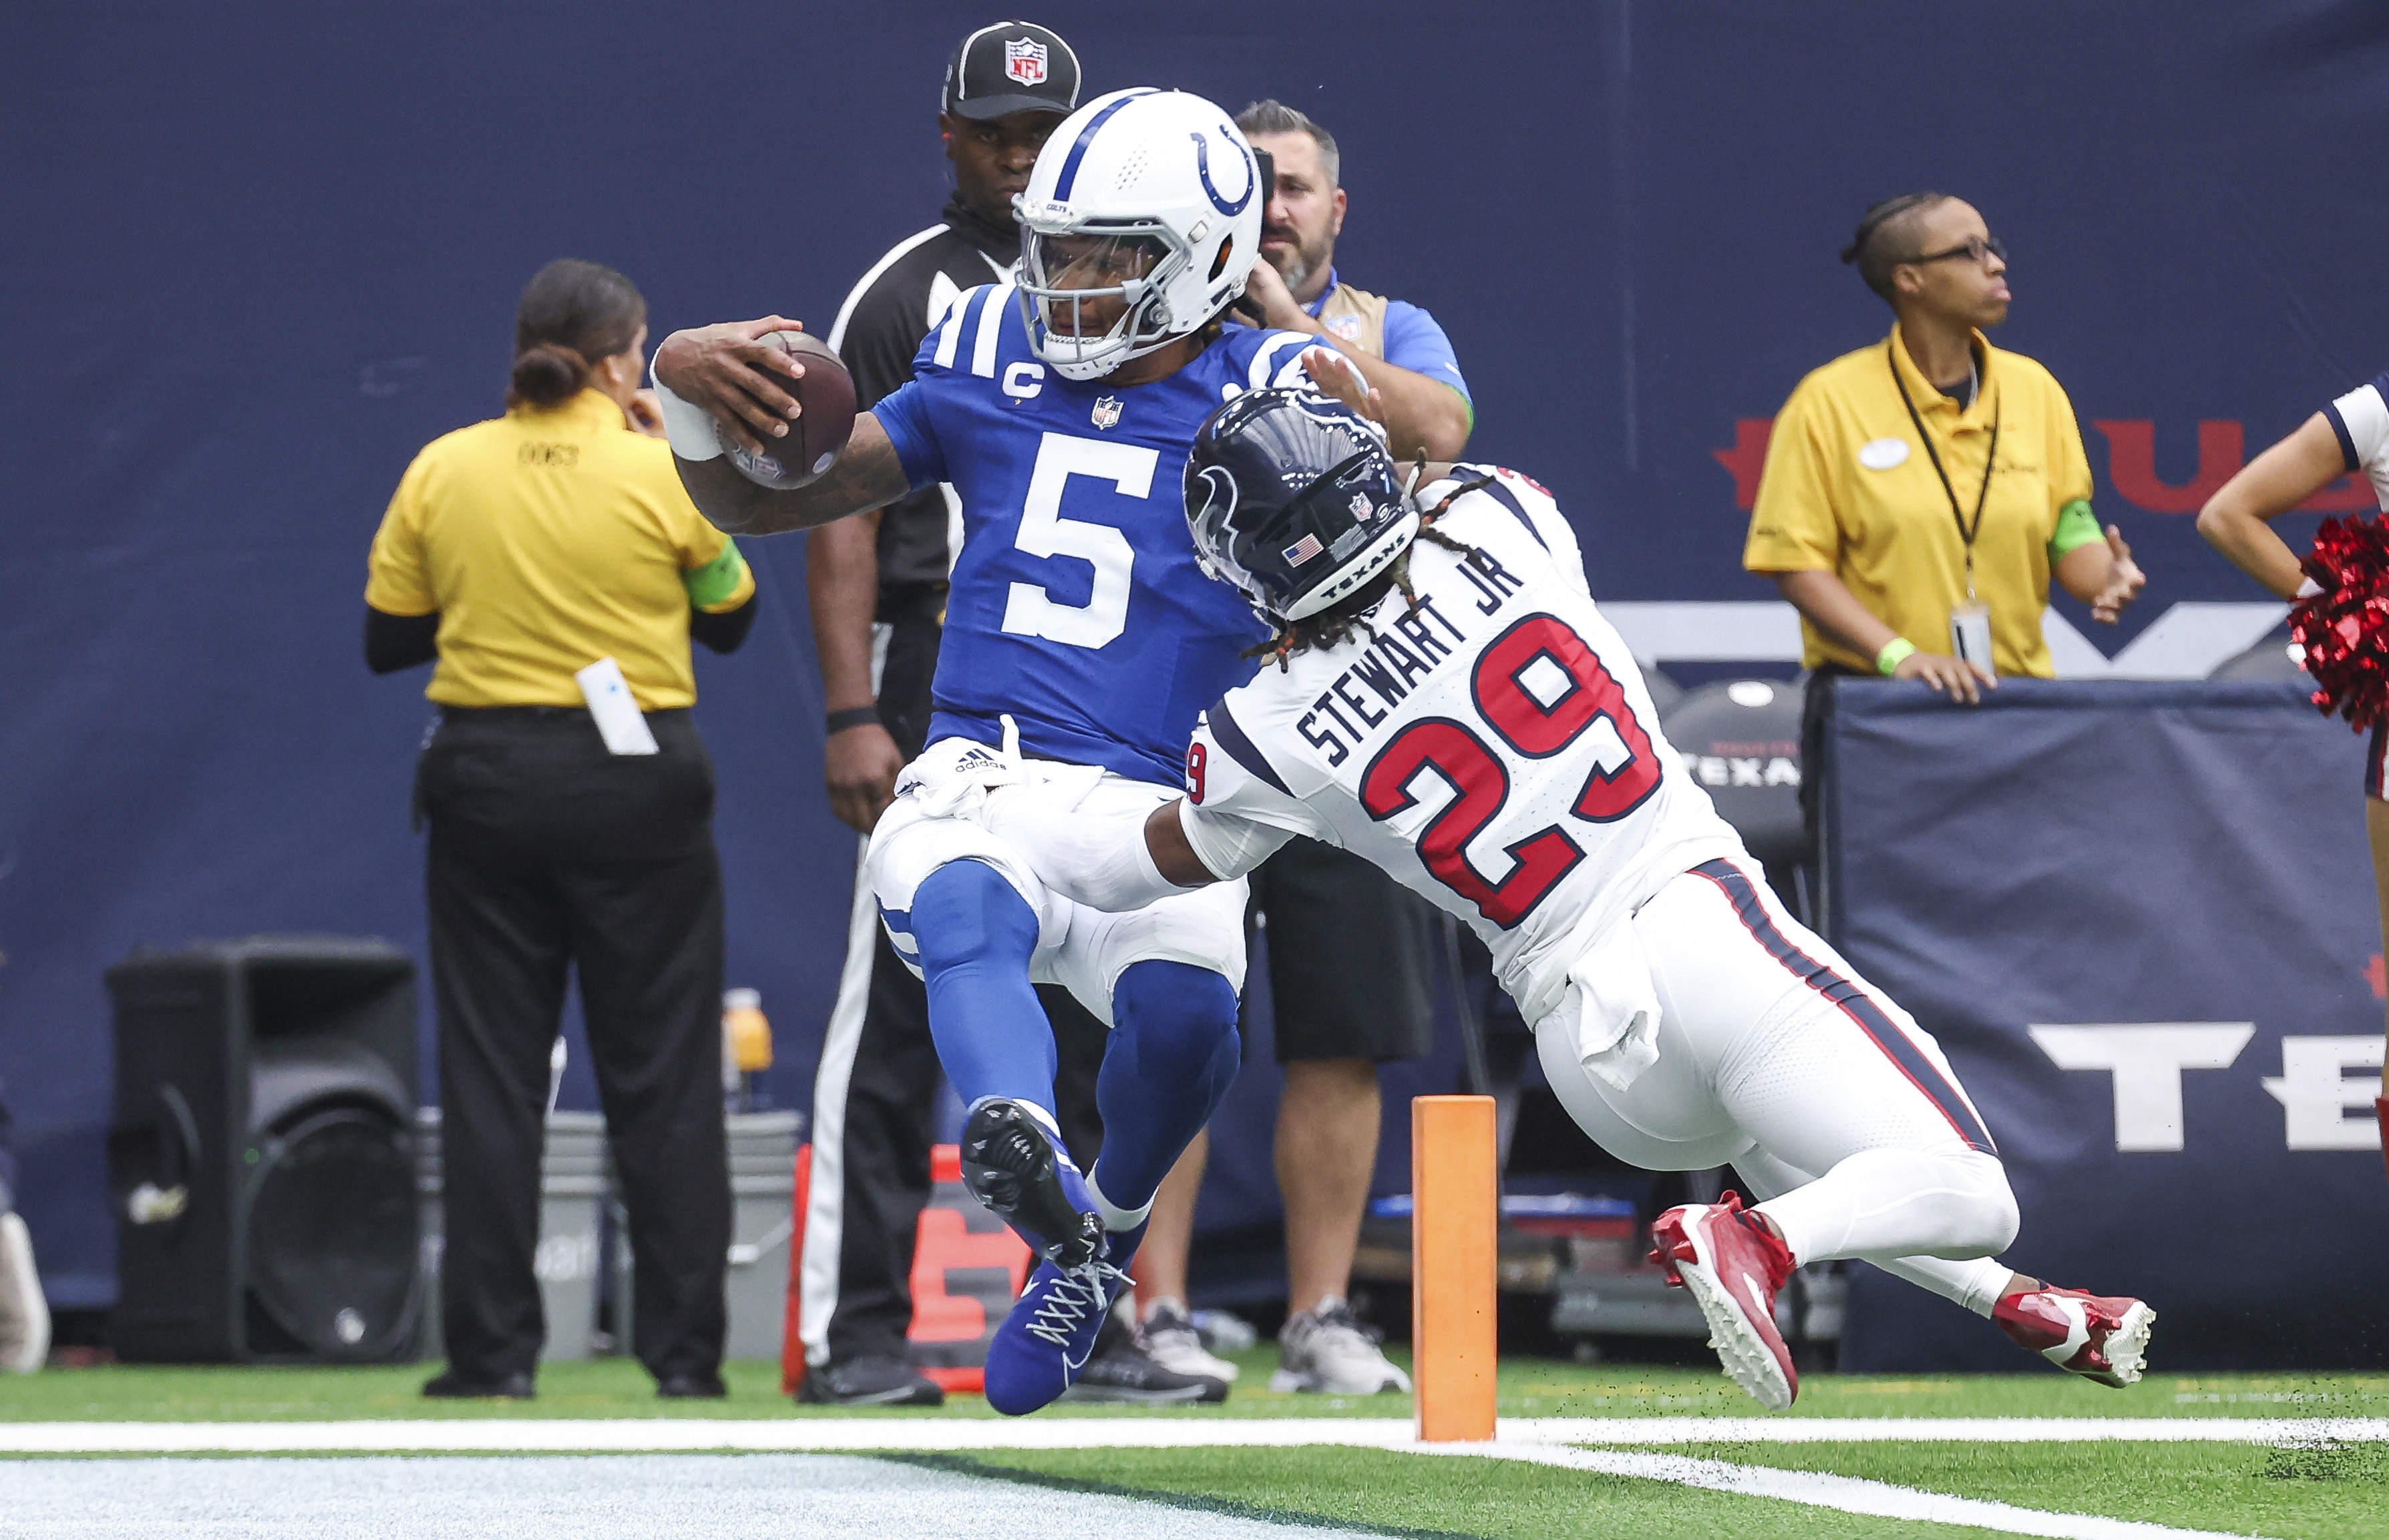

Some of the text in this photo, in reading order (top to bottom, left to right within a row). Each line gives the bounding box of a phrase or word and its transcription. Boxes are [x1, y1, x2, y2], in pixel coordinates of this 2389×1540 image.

[1012, 58, 1043, 79] NFL
[1002, 361, 1045, 399] C
[1000, 431, 1161, 650] 5
[1320, 532, 1406, 599] TEXANS
[1296, 593, 1467, 768] STEWART
[1455, 546, 1525, 616] JR
[955, 760, 1007, 773] adidas
[1185, 741, 1208, 806] 9
[1358, 611, 1664, 932] 29
